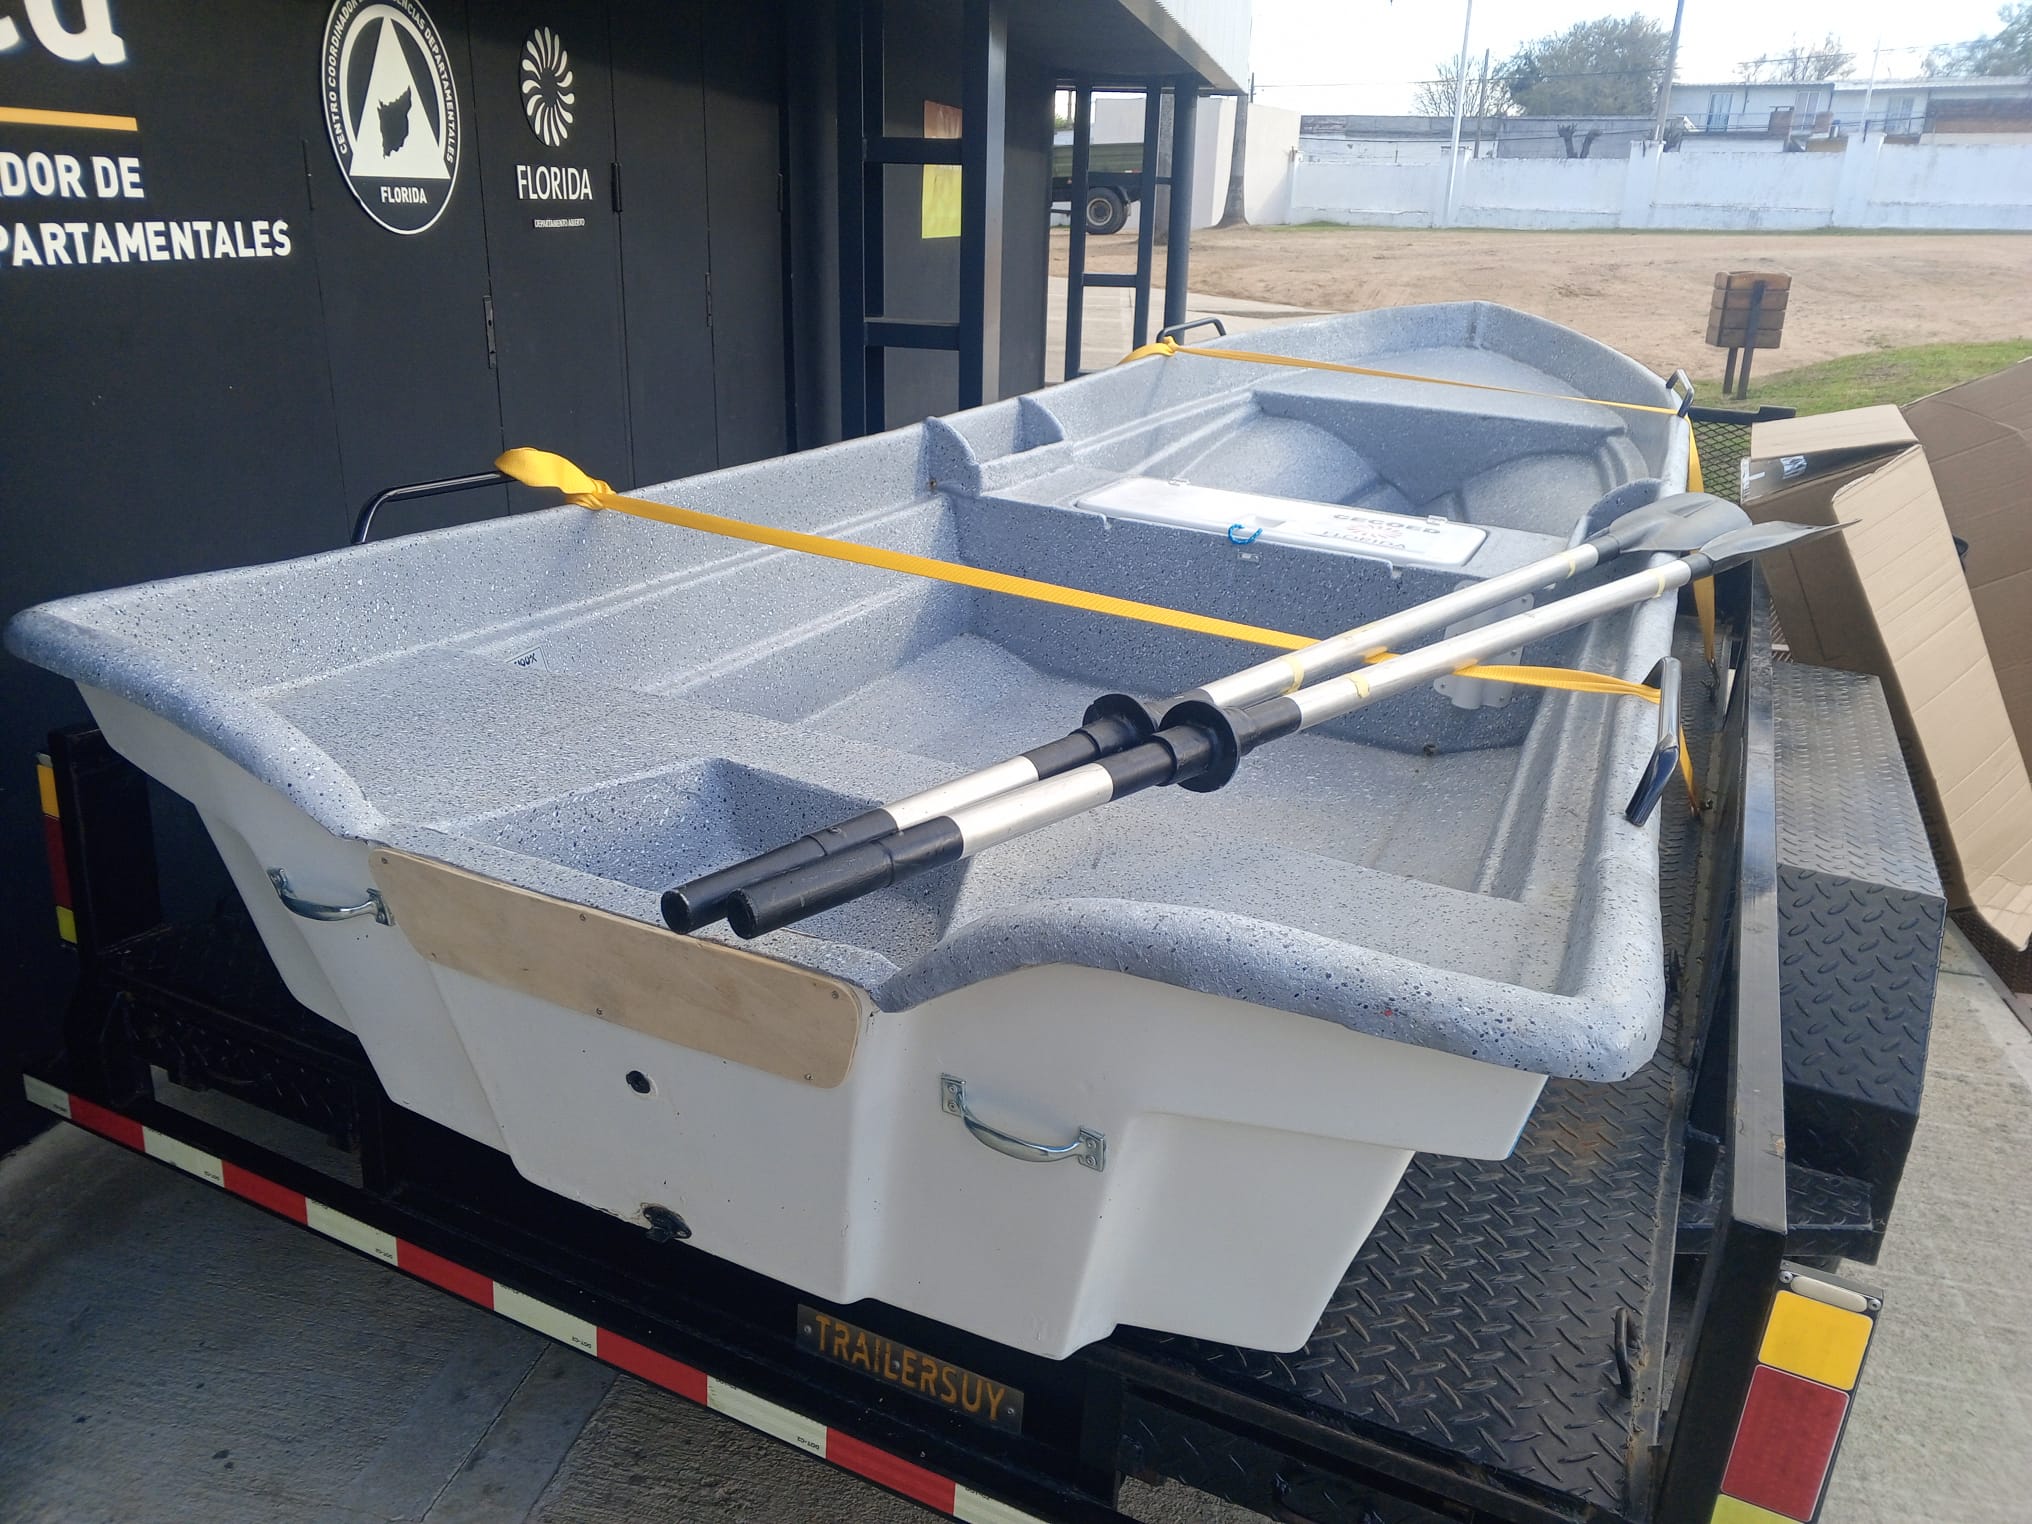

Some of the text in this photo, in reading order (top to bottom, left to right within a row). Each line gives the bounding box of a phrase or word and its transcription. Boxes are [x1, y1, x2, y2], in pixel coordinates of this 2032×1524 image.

[328, 91, 348, 155] CENTRO
[424, 28, 458, 164] DEPARTAMENTALES
[0, 151, 145, 198] DOR DE
[380, 186, 428, 204] FLORIDA
[516, 164, 593, 200] FLORIDA
[815, 1314, 1007, 1422] TRAILERSUY
